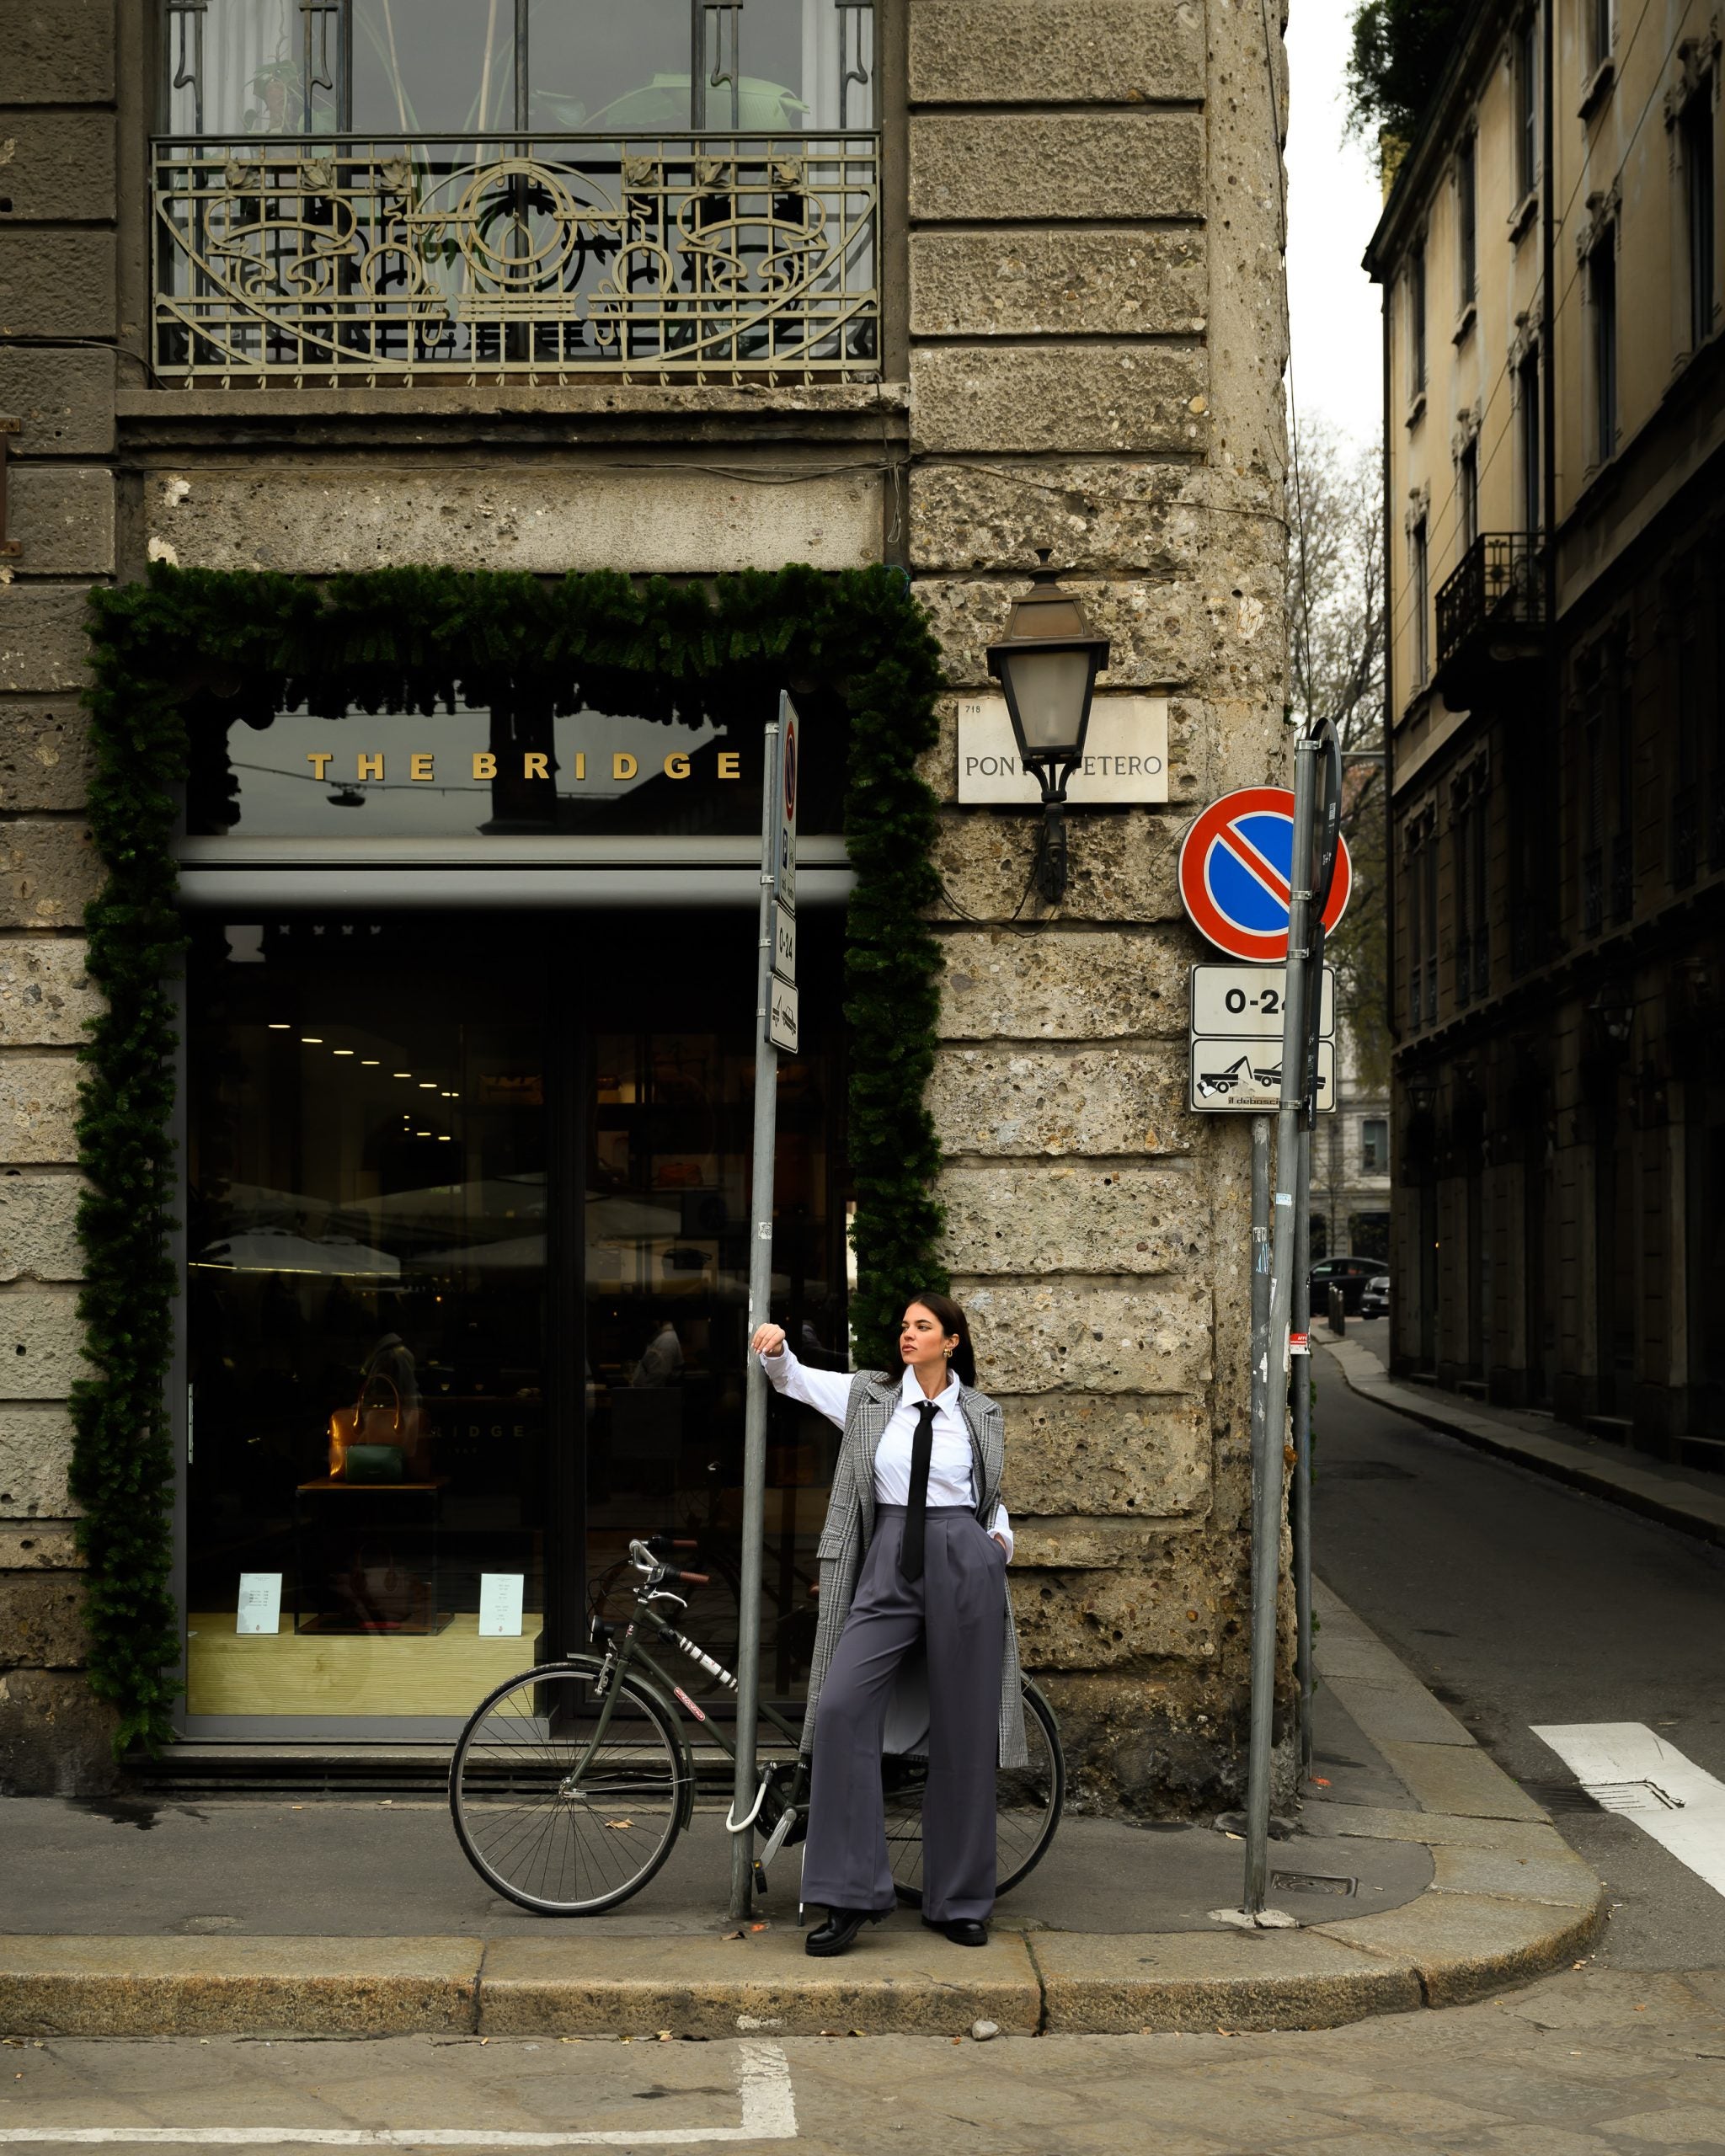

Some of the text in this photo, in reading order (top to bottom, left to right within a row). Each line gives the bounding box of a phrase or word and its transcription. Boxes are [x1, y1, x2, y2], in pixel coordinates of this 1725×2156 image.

[965, 705, 980, 713] 718
[307, 752, 741, 782] THE BRIDGE
[965, 756, 1162, 776] PON ETERO
[779, 927, 793, 962] 0-24
[1225, 988, 1285, 1014] 0-2
[1236, 1097, 1279, 1105] debosci
